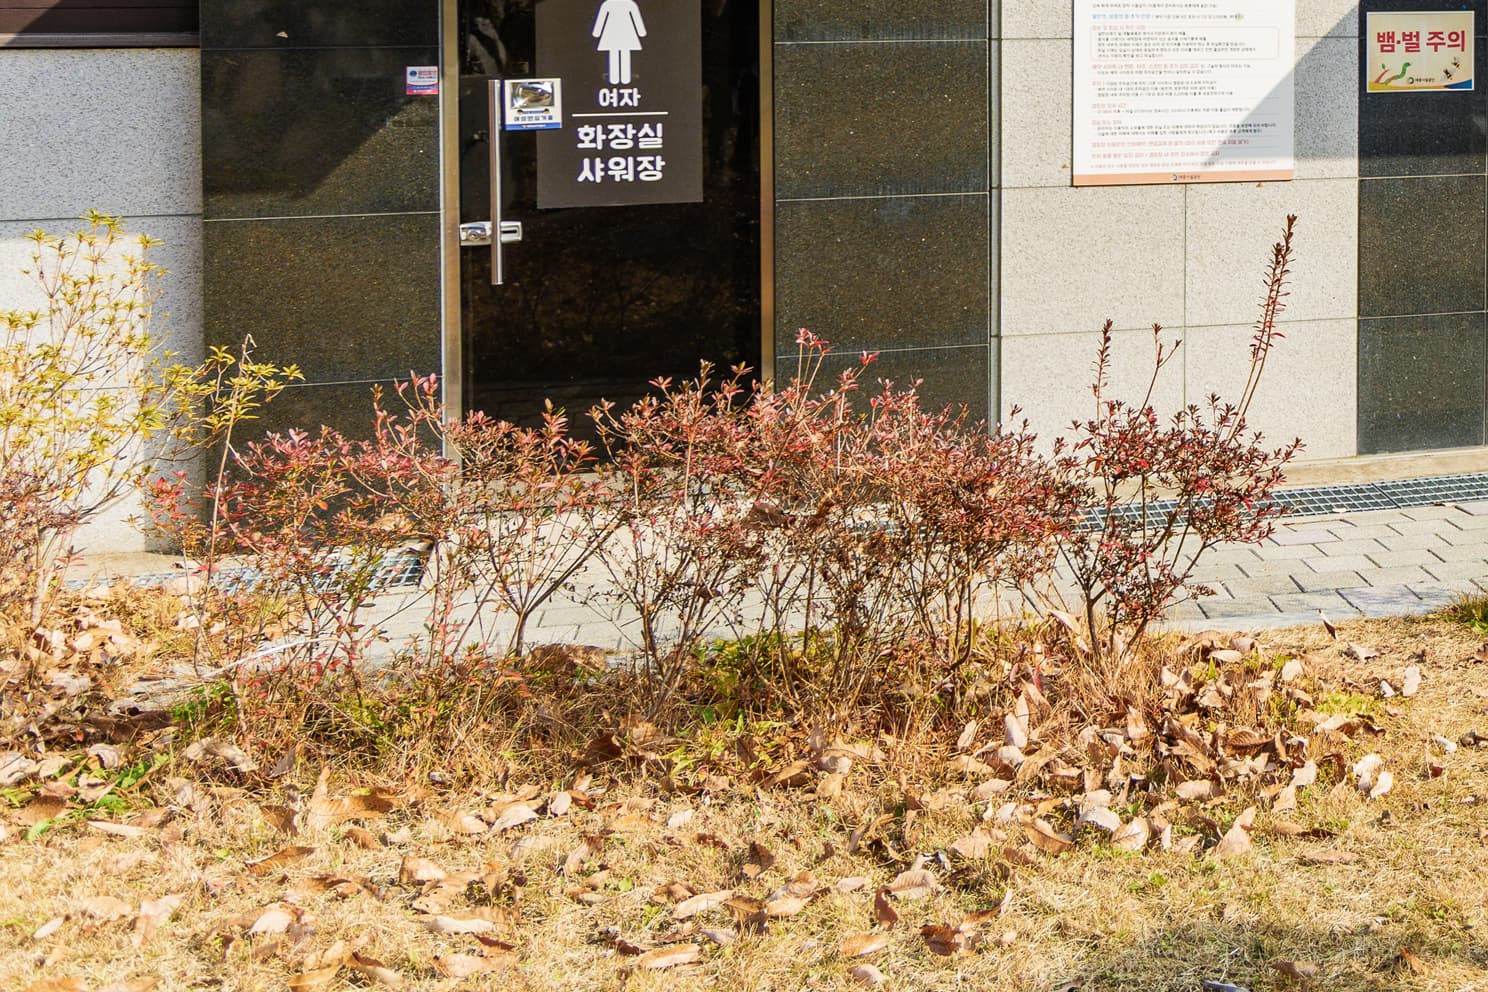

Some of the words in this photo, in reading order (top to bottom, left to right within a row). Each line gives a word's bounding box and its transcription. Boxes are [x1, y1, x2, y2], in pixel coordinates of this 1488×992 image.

[1426, 30, 1466, 52] 주의
[598, 88, 641, 107] 여자
[576, 123, 663, 150] 화장실
[577, 155, 666, 183] 샤워장
